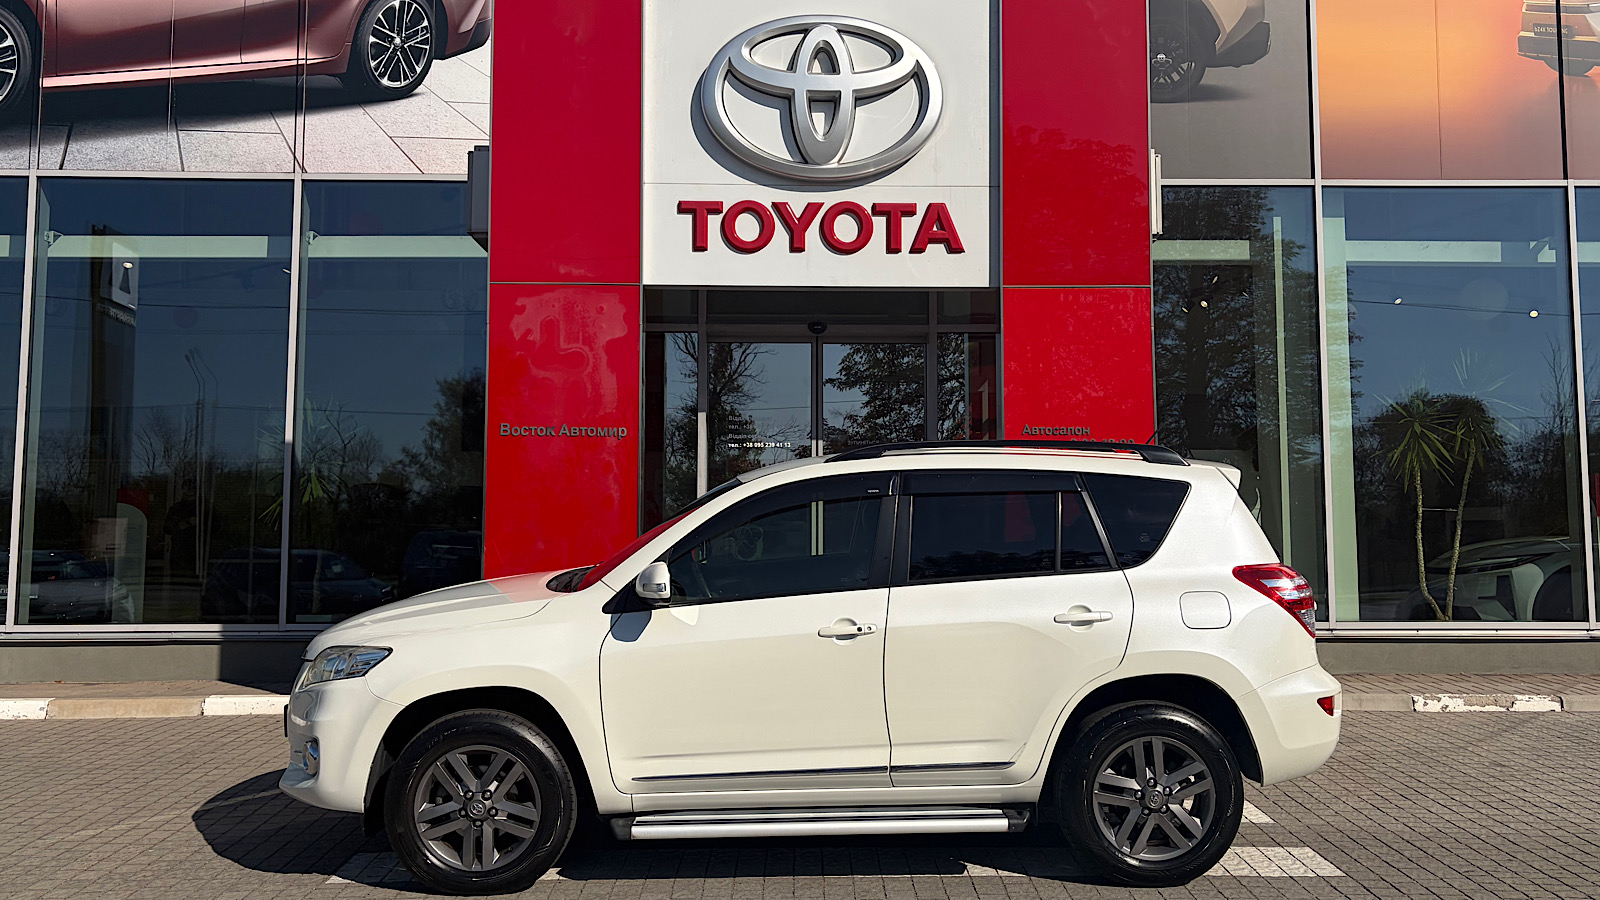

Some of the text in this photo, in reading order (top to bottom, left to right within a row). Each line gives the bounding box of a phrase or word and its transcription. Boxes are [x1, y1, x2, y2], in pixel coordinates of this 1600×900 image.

[677, 200, 965, 255] TOYOTA
[500, 423, 628, 440] Восток Автомир
[1022, 424, 1091, 436] Автосалон
